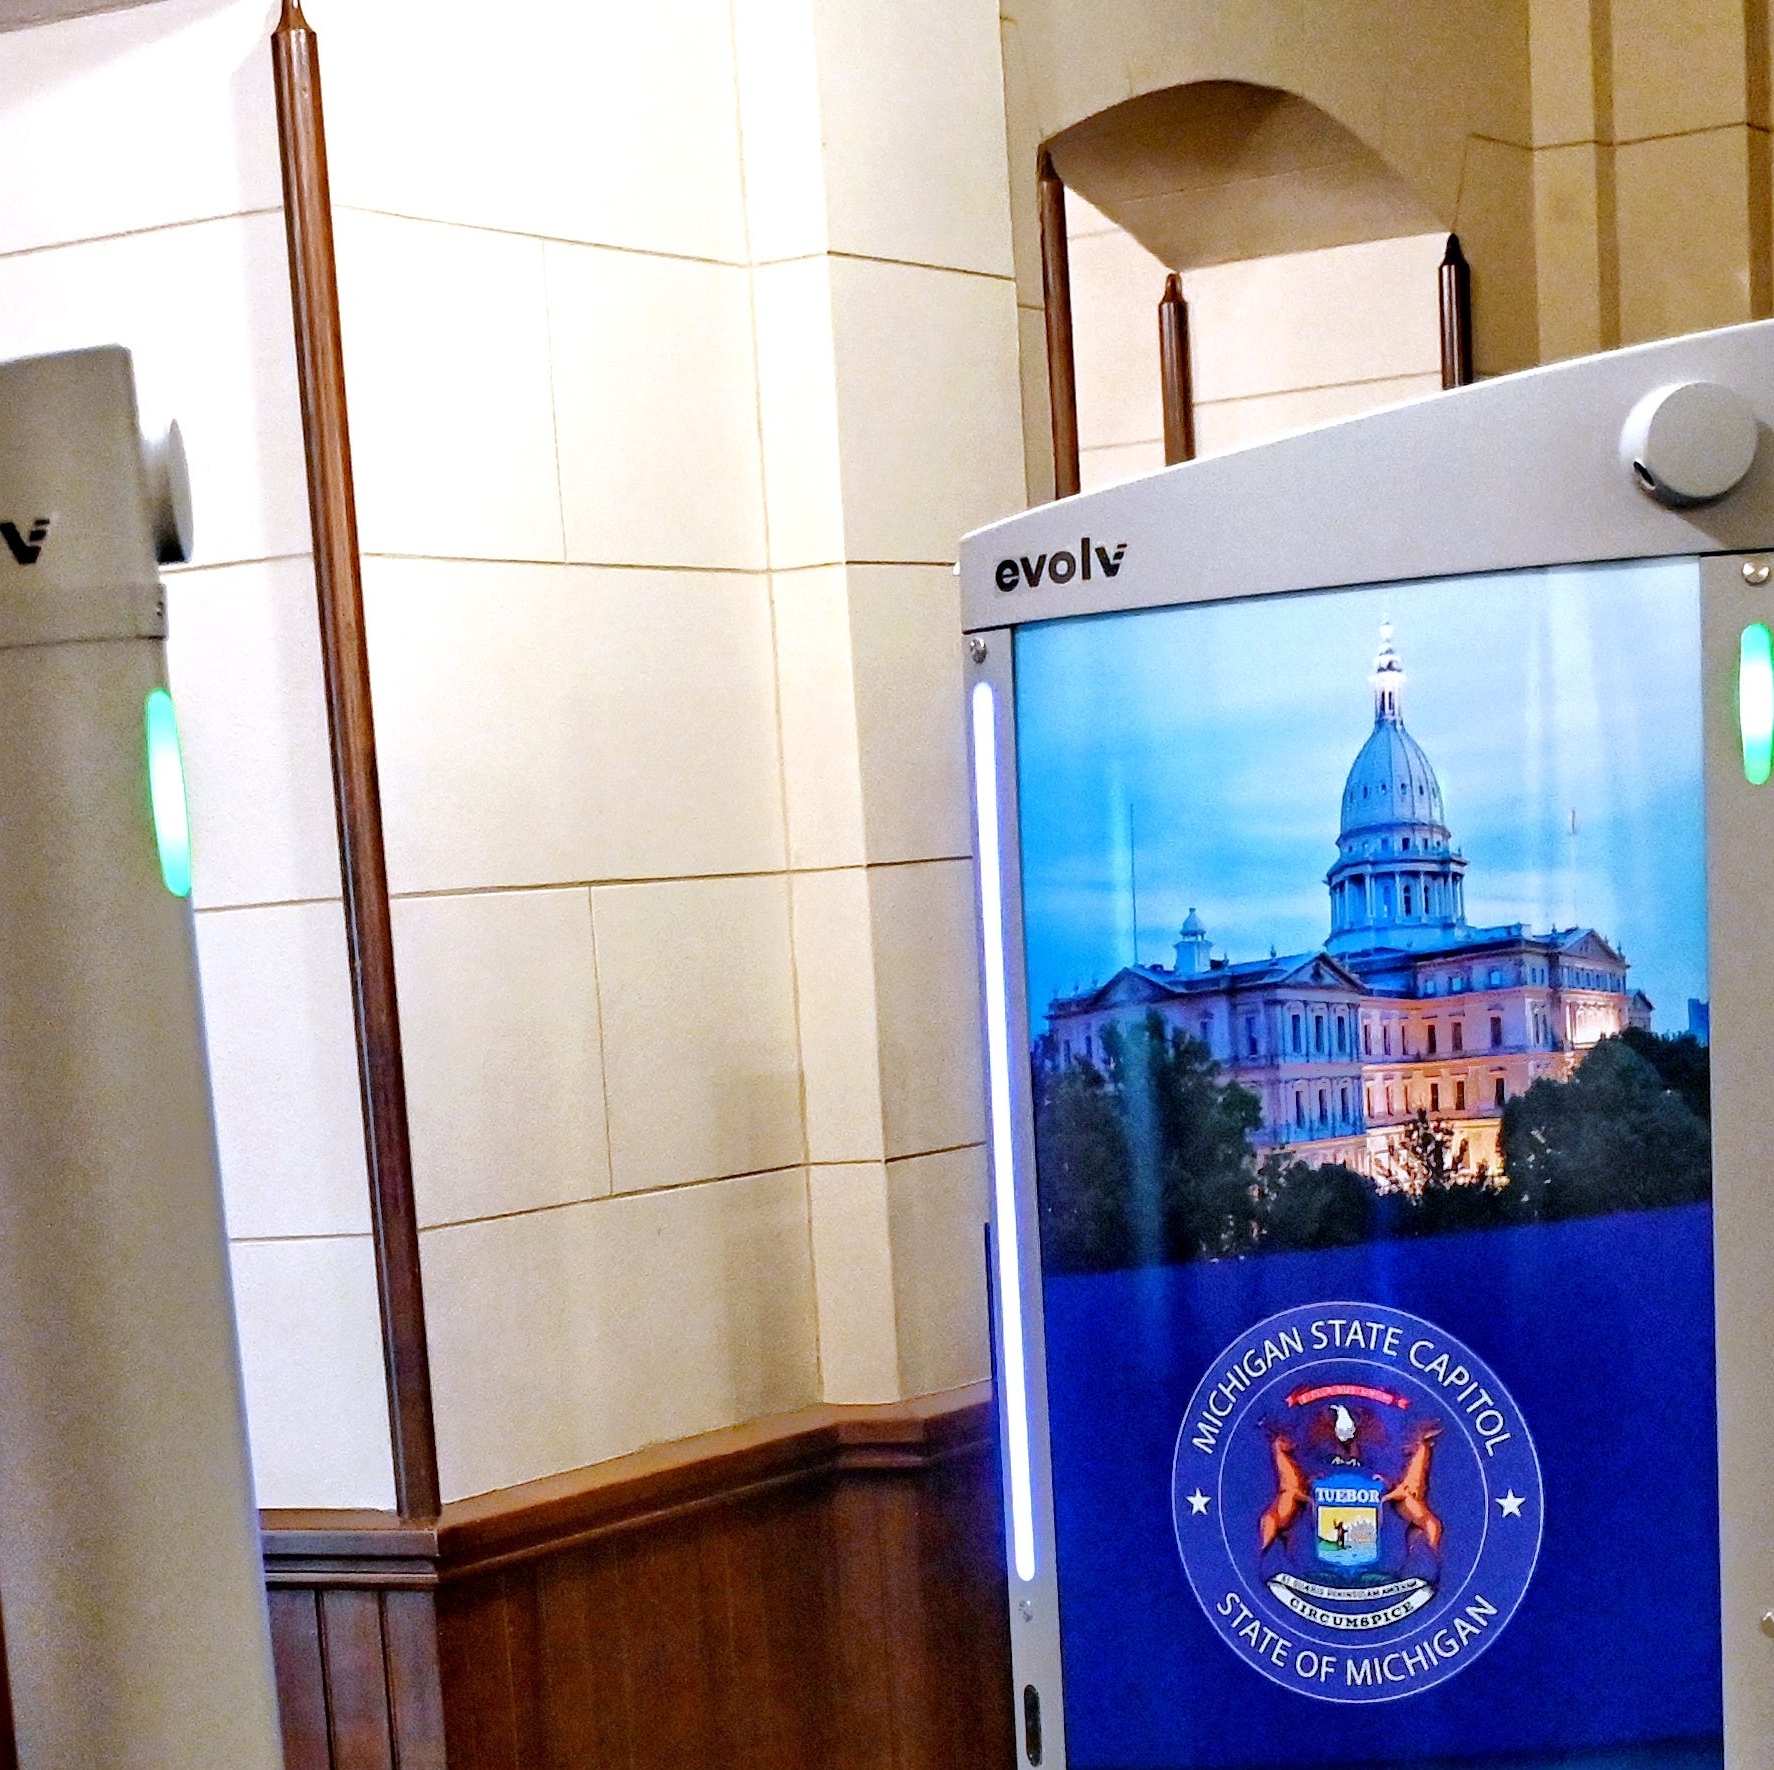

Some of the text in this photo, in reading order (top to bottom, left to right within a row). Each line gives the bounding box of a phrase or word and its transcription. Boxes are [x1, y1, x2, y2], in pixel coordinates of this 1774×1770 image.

[995, 537, 1128, 592] evolv
[1192, 1319, 1512, 1458] MICHIGAN STATE CAPITOL
[1216, 1591, 1499, 1687] STATE OF MICHIGAN
[1290, 1597, 1415, 1628] CIRCUMSPICE
